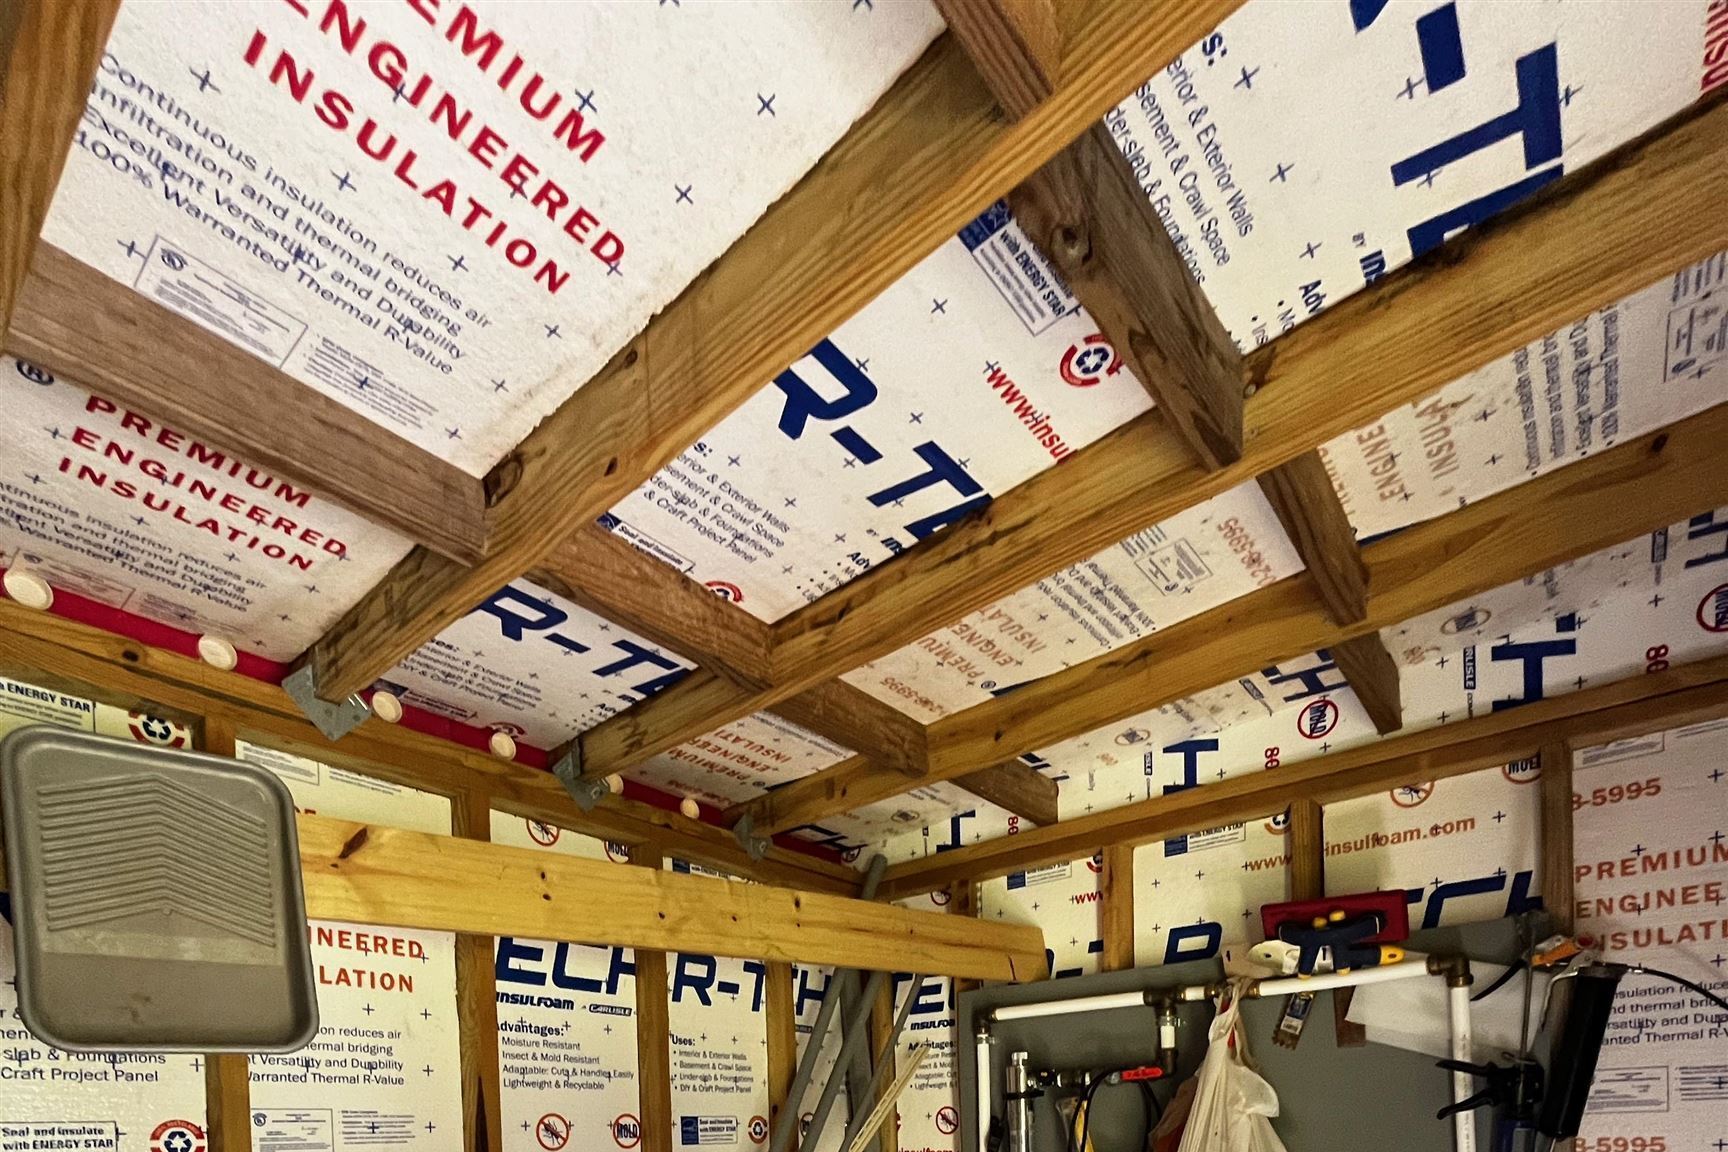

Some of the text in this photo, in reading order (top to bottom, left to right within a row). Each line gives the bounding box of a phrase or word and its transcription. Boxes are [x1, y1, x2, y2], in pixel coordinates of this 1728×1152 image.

[284, 0, 624, 264] NGINEERED
[243, 29, 570, 294] INSULATION
[100, 52, 258, 171] Continuous
[264, 165, 378, 254] insulation
[382, 250, 462, 311] reduces
[466, 305, 493, 331] air
[1196, 123, 1254, 238] Exterior Walls
[1178, 171, 1212, 221] Crawl
[1200, 210, 1230, 268] Space
[213, 182, 328, 274] Versatility
[330, 264, 374, 301] and
[240, 179, 462, 338] and thermal bridging
[163, 184, 291, 274] Warranted
[297, 268, 382, 332] Thermal
[384, 324, 454, 378] R-Value
[1015, 250, 1066, 317] ENERGY STAR
[85, 395, 313, 509] PREMIUM
[71, 426, 348, 557] ENGINEERED
[58, 456, 315, 571] INSULATION
[718, 480, 791, 533] Exterior Walls
[721, 499, 754, 527] Crawl
[656, 497, 757, 564] Craft Project Panel
[7, 682, 56, 708] ENERGY
[60, 694, 91, 713] STAR
[319, 965, 414, 993] LATION
[1630, 1000, 1686, 1014] thermal
[1661, 1015, 1689, 1027] and
[339, 1028, 401, 1039] reduces air
[502, 1037, 580, 1050] Moisture Resistant
[671, 1034, 695, 1046] Uses:
[1645, 1030, 1704, 1043] Thermal
[348, 1043, 393, 1056] bridging
[502, 1051, 600, 1064] Insect Mold Resistant
[1, 1067, 159, 1084] Craft Project Panel
[325, 1058, 347, 1068] and
[351, 1058, 404, 1071] Durability
[311, 1073, 360, 1084] Thermal
[363, 1074, 405, 1085] R-Value
[503, 1078, 604, 1090] Lightweight Recyclable
[2, 1126, 56, 1137] Seal and
[3, 1139, 114, 1151] with ENERGY STAR
